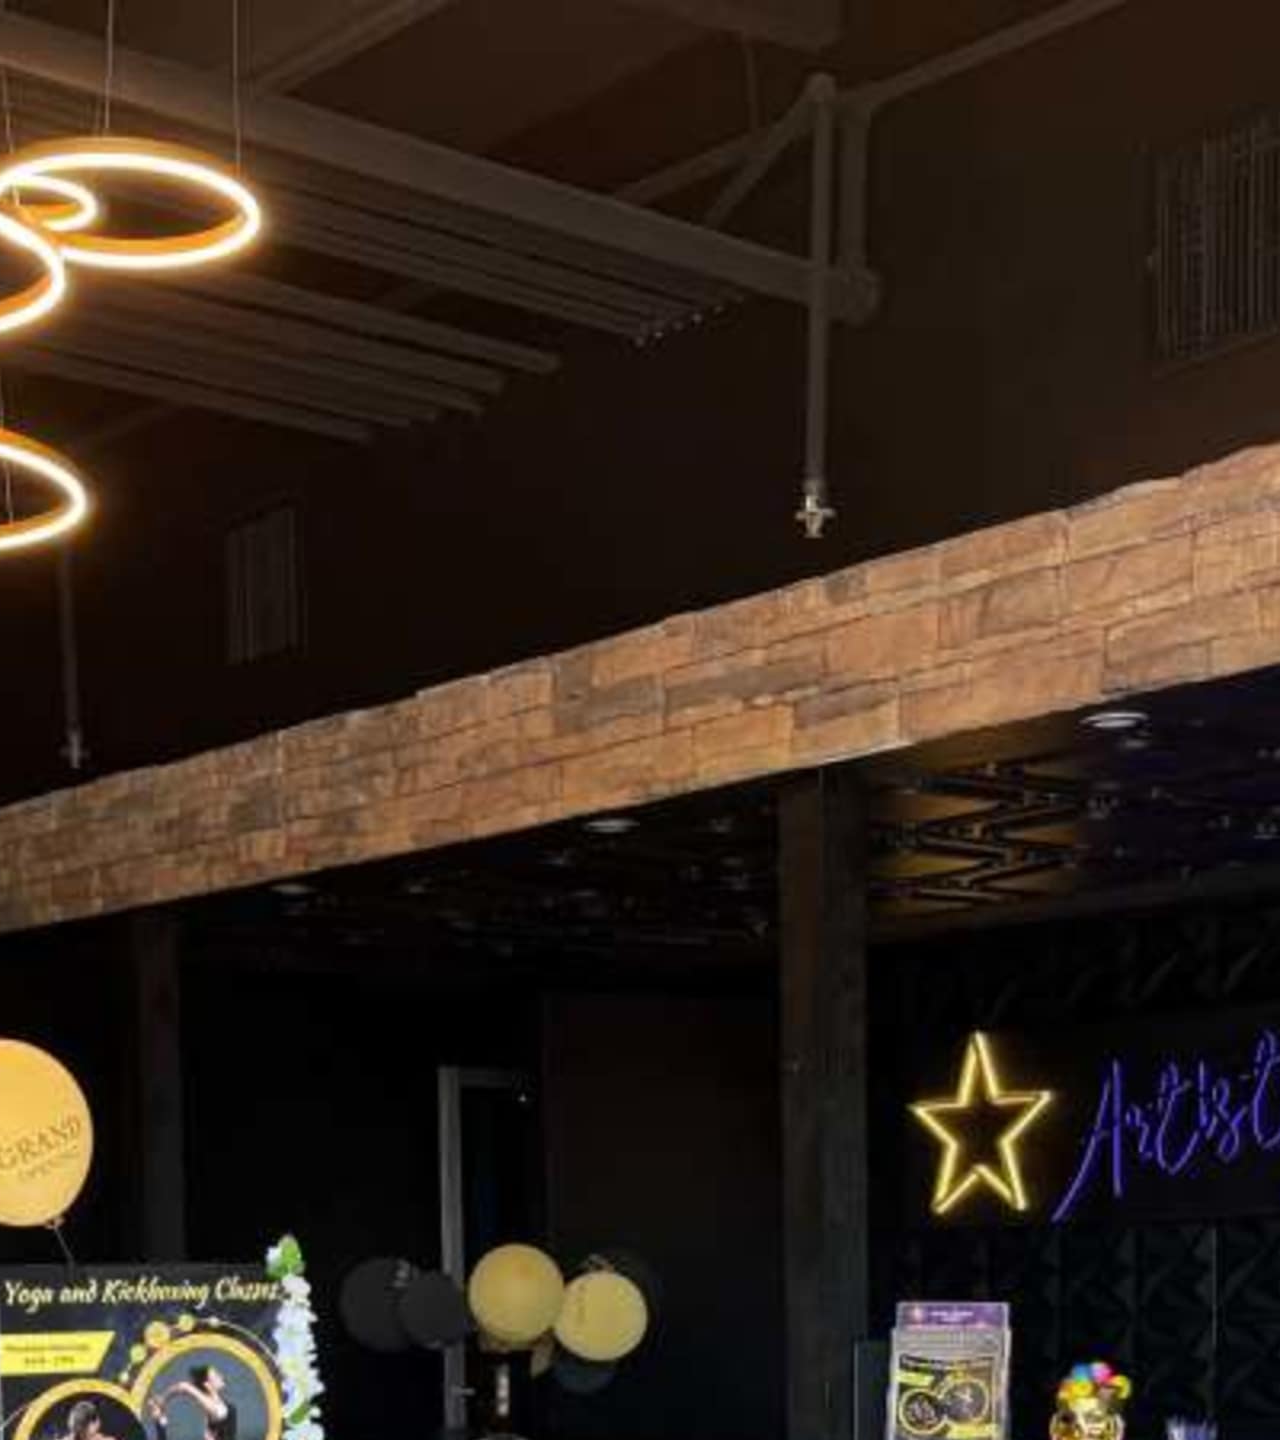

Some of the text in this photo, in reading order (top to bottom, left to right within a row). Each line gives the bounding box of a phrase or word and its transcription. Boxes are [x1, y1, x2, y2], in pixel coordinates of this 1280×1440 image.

[5, 1281, 53, 1313] Yoga
[60, 1278, 98, 1304] and
[101, 1275, 210, 1310] Kickboxing
